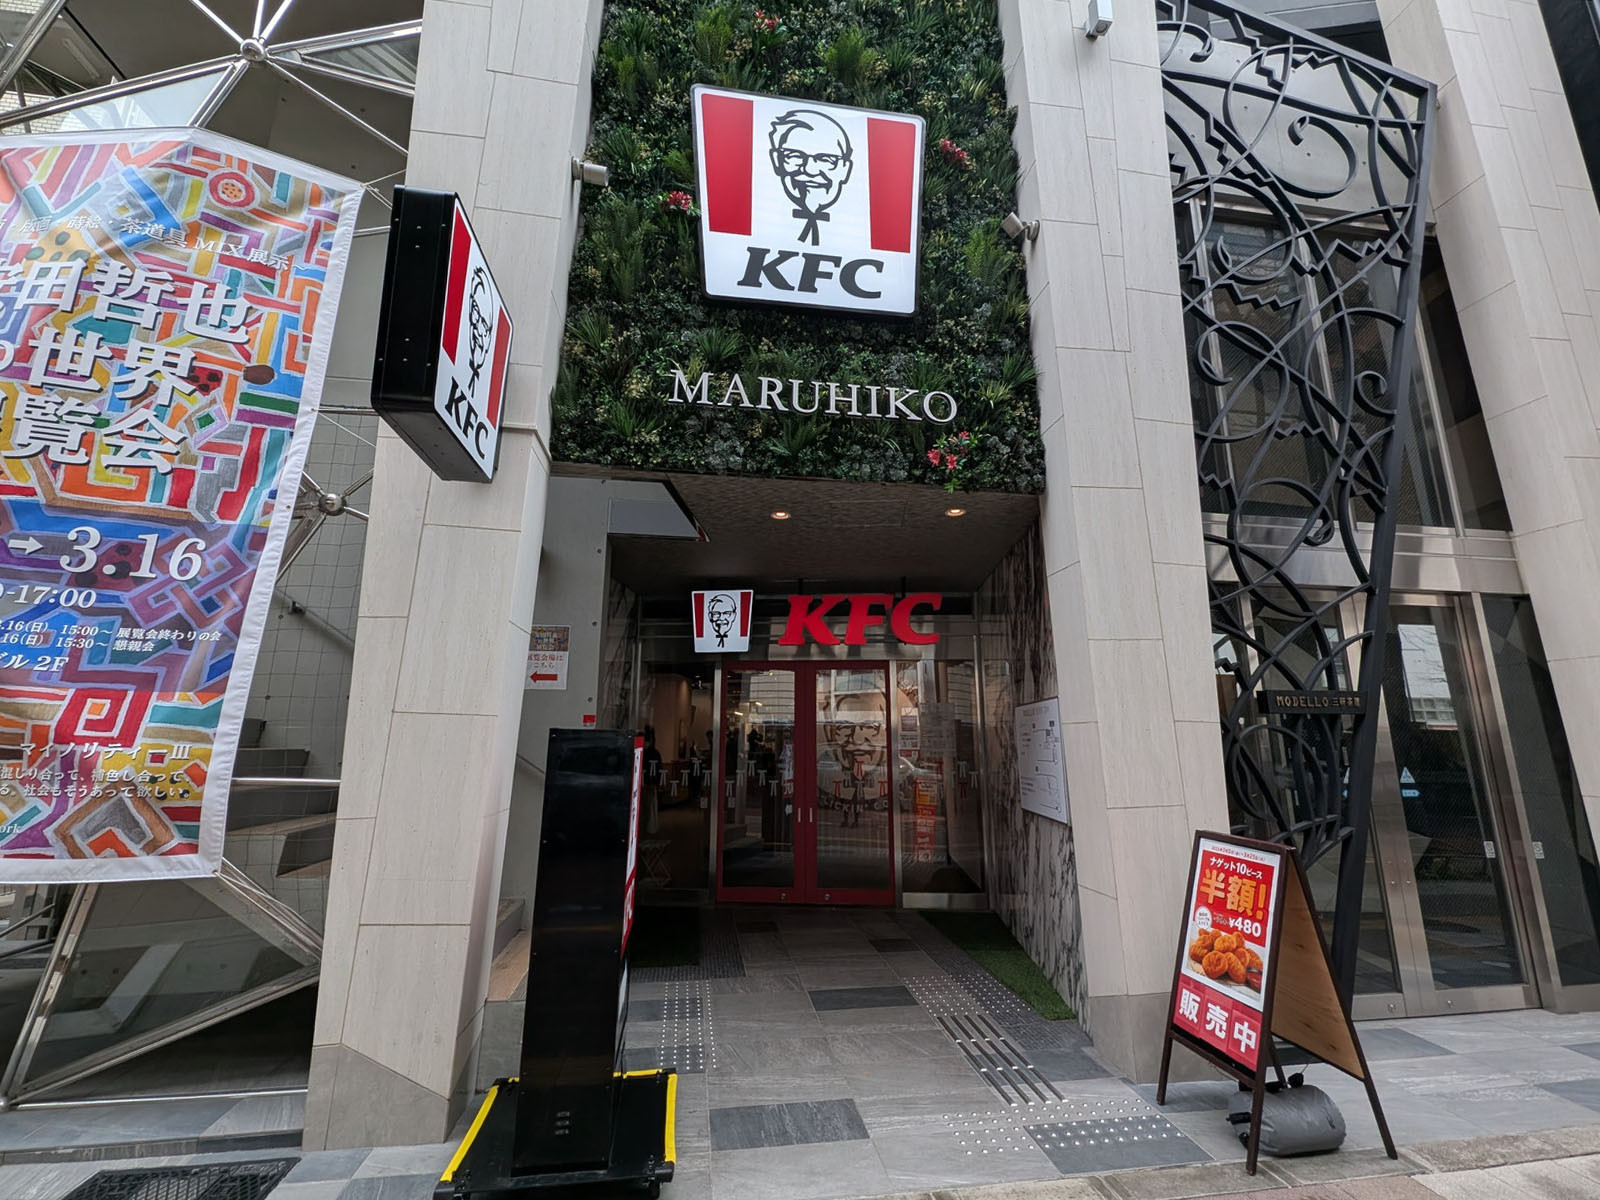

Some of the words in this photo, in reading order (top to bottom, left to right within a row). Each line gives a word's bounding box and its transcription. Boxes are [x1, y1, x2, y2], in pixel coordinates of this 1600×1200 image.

[737, 246, 885, 299] KFC
[0, 257, 252, 344] 田哲也
[0, 325, 202, 406] 世界
[444, 376, 490, 461] KFC
[668, 369, 958, 424] MARUHIKO
[0, 390, 189, 474] 覧会
[60, 525, 207, 582] 3.16
[0, 584, 97, 609] -17:00
[778, 593, 943, 646] KFC
[33, 656, 70, 672] 2F
[1276, 695, 1329, 707] MODELLO
[1210, 856, 1263, 880] ナゲット10ピース
[1228, 917, 1262, 937] ¥480
[1179, 988, 1256, 1053] 販売中
